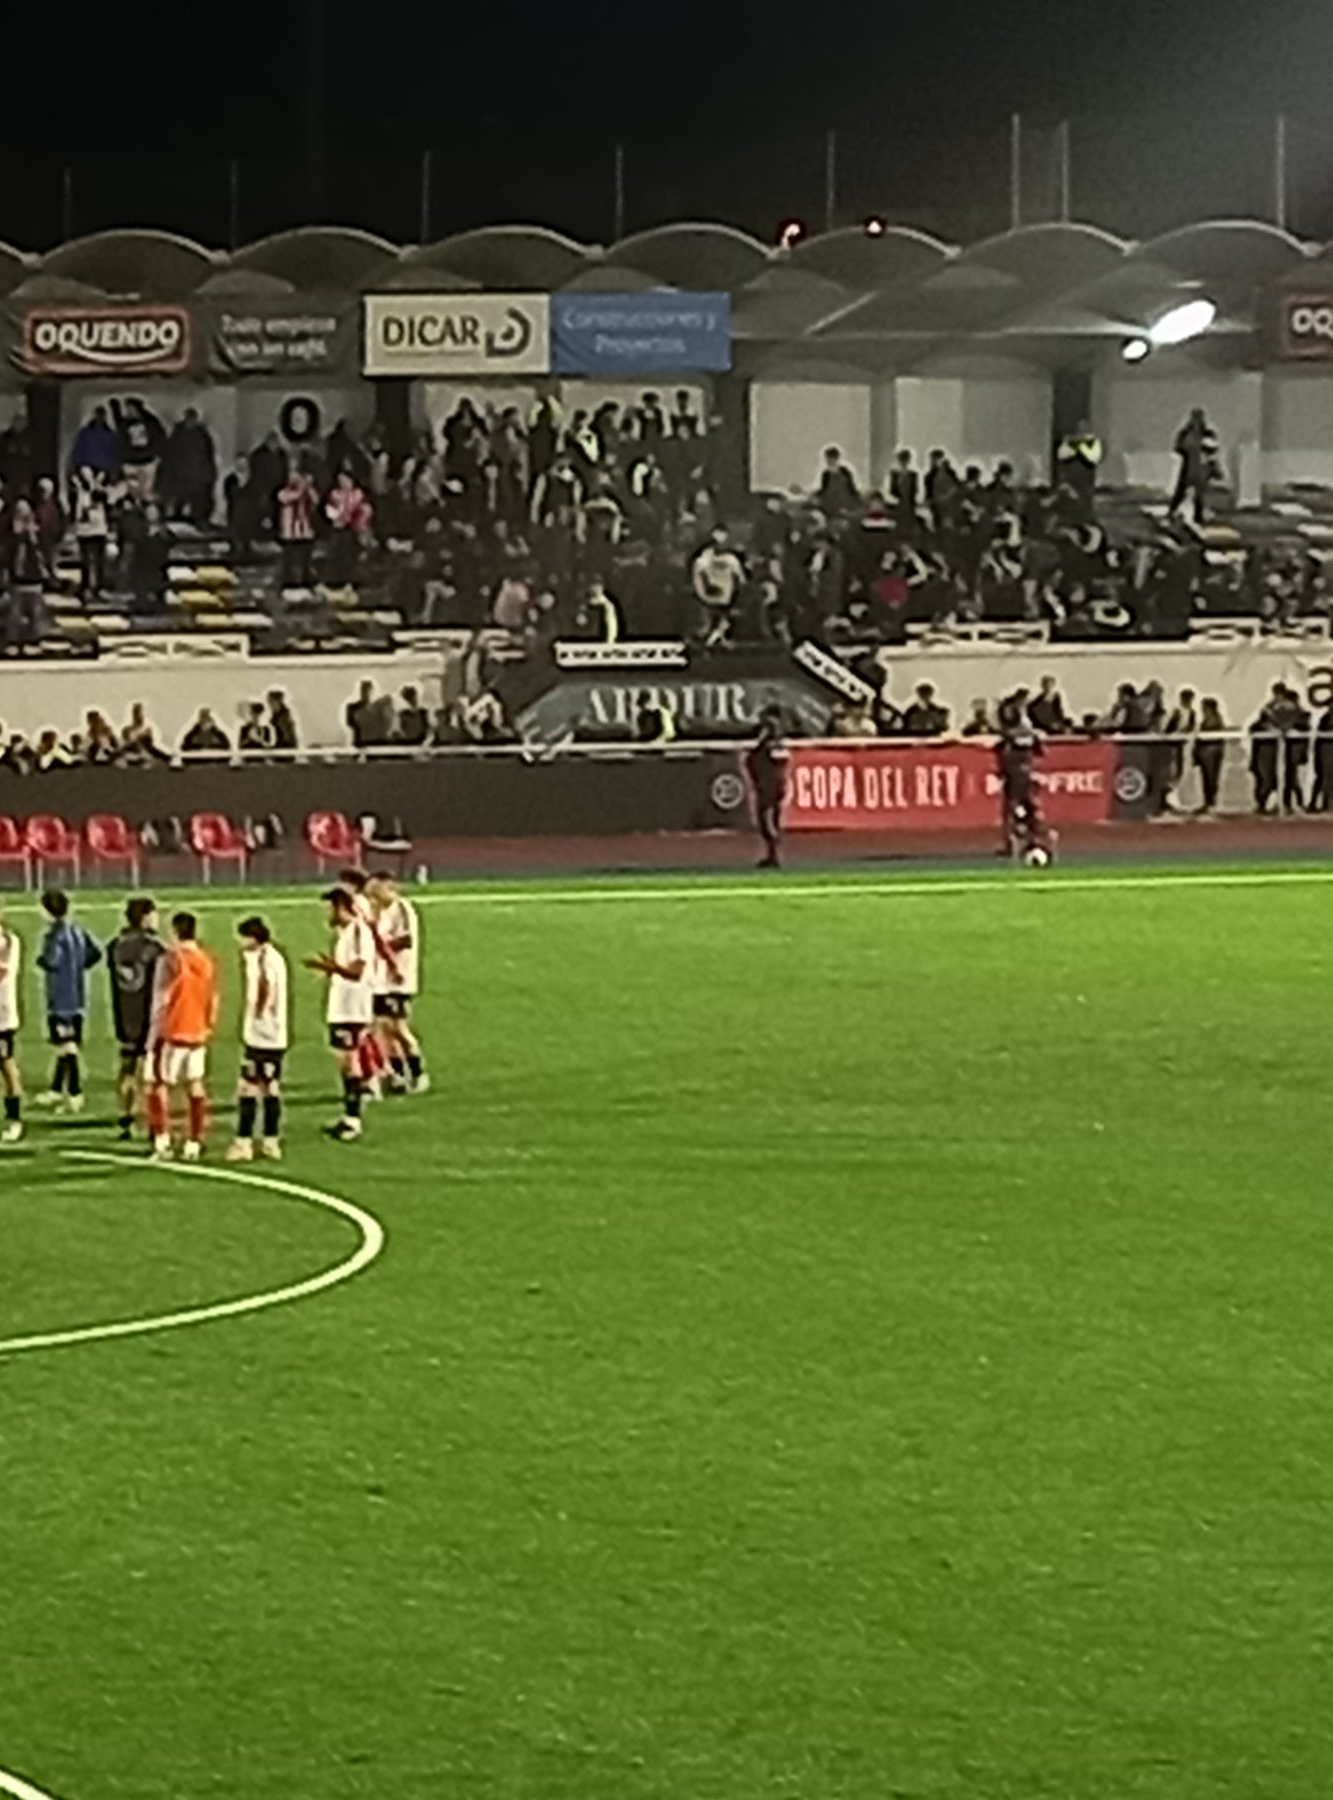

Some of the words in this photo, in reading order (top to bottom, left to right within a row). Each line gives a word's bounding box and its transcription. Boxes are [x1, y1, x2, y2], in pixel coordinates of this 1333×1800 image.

[35, 319, 181, 363] OQUENDO
[383, 316, 480, 347] DICAR
[796, 765, 857, 809] COPA
[863, 767, 908, 809] DEL
[914, 765, 960, 808] REY
